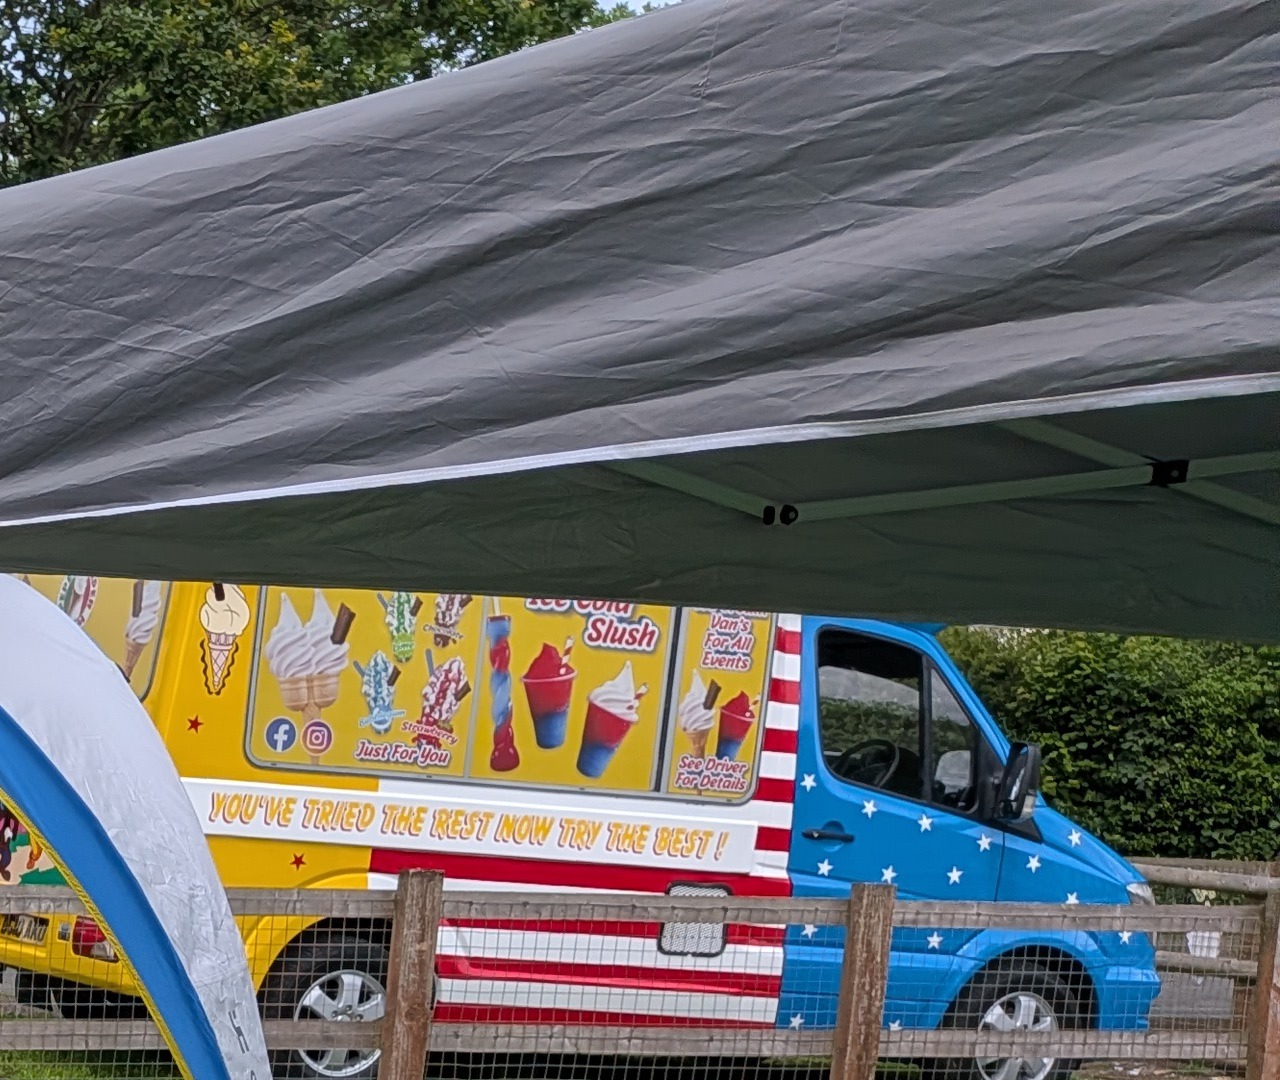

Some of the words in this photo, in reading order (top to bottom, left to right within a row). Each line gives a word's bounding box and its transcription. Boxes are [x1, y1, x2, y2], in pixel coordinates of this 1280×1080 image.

[711, 614, 750, 631] Van's
[587, 618, 656, 648] Slush
[704, 633, 729, 648] For
[730, 635, 752, 650] All
[702, 651, 748, 669] Events
[401, 722, 458, 745] Strawberry
[355, 741, 388, 759] Just
[391, 744, 418, 761] For
[420, 745, 449, 765] You
[679, 755, 703, 769] See
[705, 758, 747, 774] Driver
[675, 771, 698, 786] For
[700, 775, 747, 790] Details
[208, 792, 294, 826] YOU'VE
[301, 798, 374, 832] TRIED
[380, 804, 425, 837] THE
[432, 808, 494, 842] REST
[495, 814, 553, 848] NOW
[559, 818, 603, 852] TRY
[604, 821, 650, 854] THE
[653, 826, 713, 860] BEST
